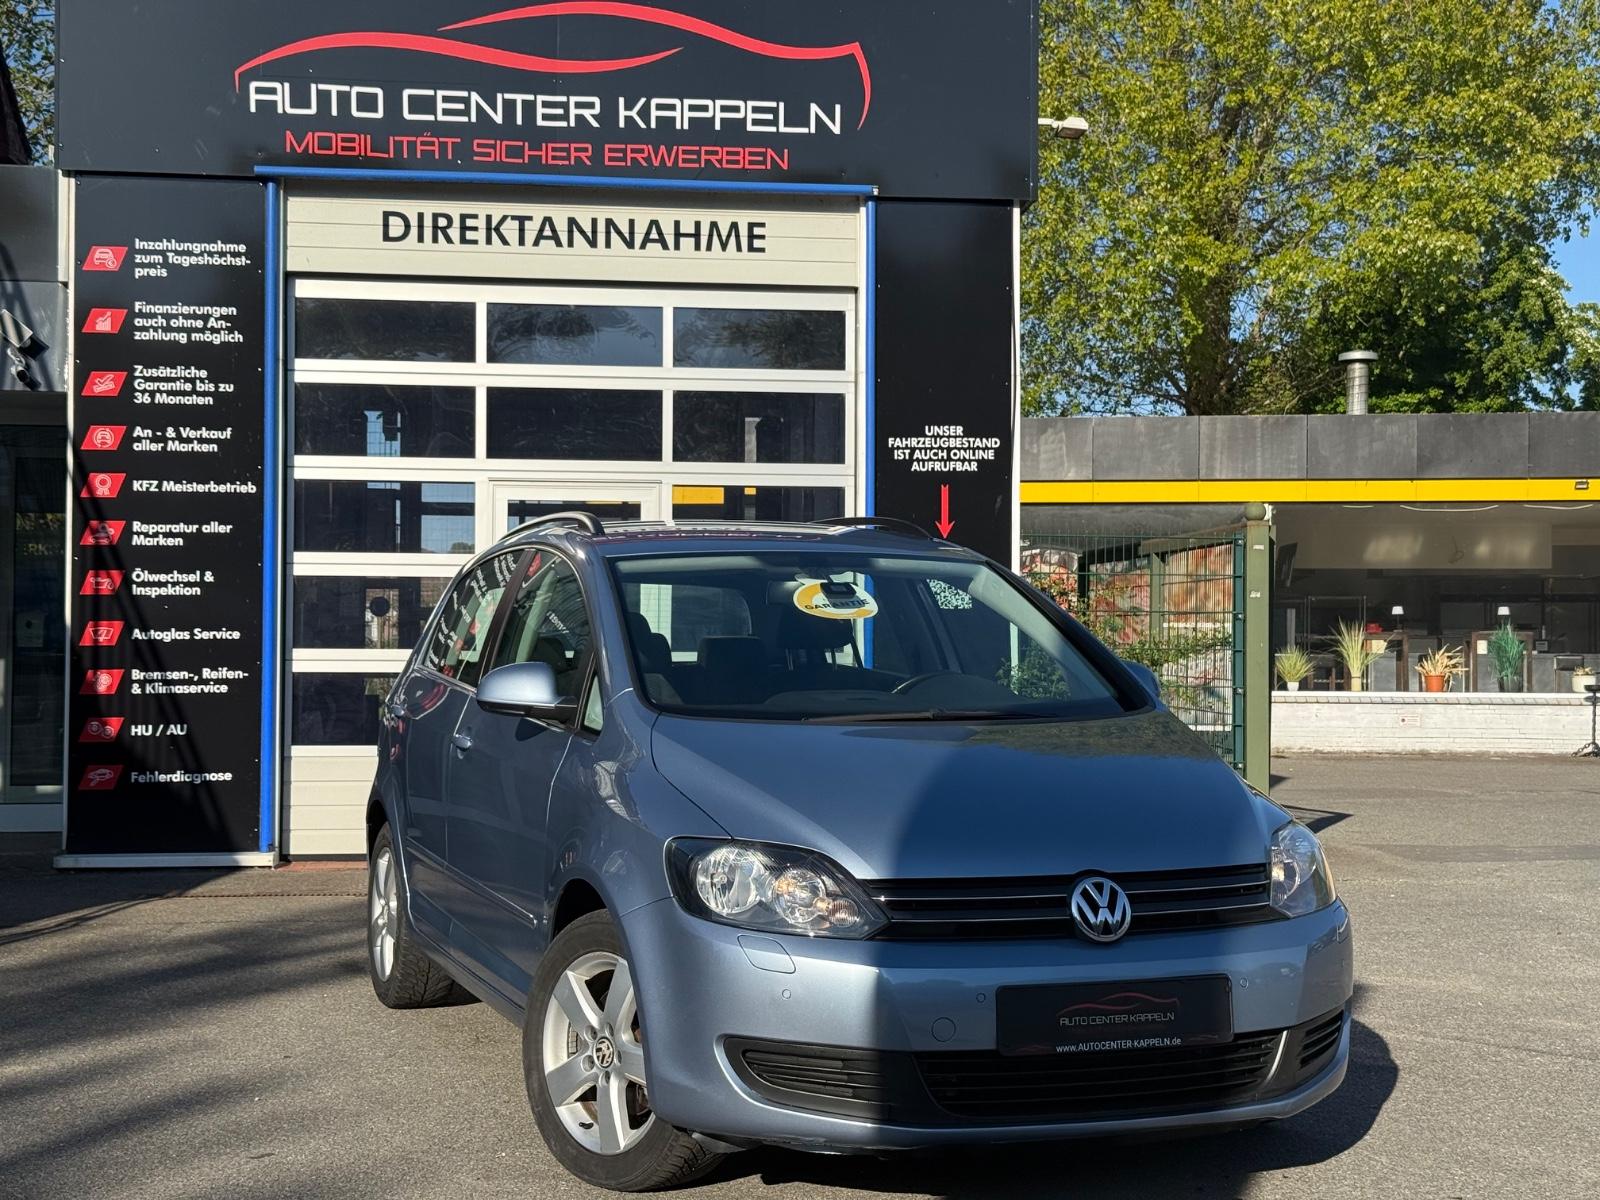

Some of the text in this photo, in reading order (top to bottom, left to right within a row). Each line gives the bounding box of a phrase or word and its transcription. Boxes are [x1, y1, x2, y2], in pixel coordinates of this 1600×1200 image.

[249, 81, 840, 134] AUTO CENTER KAPPELN
[285, 131, 789, 169] MOBILITÄT SICHER ERWERBEN
[382, 210, 766, 253] DIREKTANNAHME
[135, 238, 246, 253] Inzahlungnahme
[135, 252, 250, 266] zum Tageshöchst-
[135, 265, 167, 279] preis
[135, 302, 237, 317] Finanzierungen
[134, 315, 231, 328] auch ohne An-
[134, 329, 243, 344] zahlung möglich
[134, 365, 207, 378] Zusätzliche
[134, 379, 233, 392] Garantie bis zu
[134, 392, 213, 404] 36 Monaten
[133, 426, 152, 437] An
[166, 427, 176, 438] &
[179, 427, 232, 439] Verkauf
[925, 426, 963, 436] UNSER
[133, 439, 217, 452] aller Marken
[889, 438, 1000, 448] FAHRZEUGBESTAND
[894, 449, 994, 459] IST AUCH ONLINE
[911, 461, 977, 471] AUFRUFBAR
[133, 480, 256, 493] KFZ Meisterbetrieb
[132, 521, 232, 534] Reparatur aller
[132, 533, 183, 545] Marken
[132, 568, 214, 582] Ölwechsel &
[132, 585, 200, 598] Inspektion
[132, 628, 240, 642] Autoglas Service
[132, 667, 248, 681] Bremsen-, Reifen-
[131, 682, 228, 694] & Klimaservice
[131, 724, 186, 736] HU / AU
[133, 771, 232, 783] Fehlerdiagnose
[1060, 1011, 1175, 1026] AUTO CENTER KAPPELN
